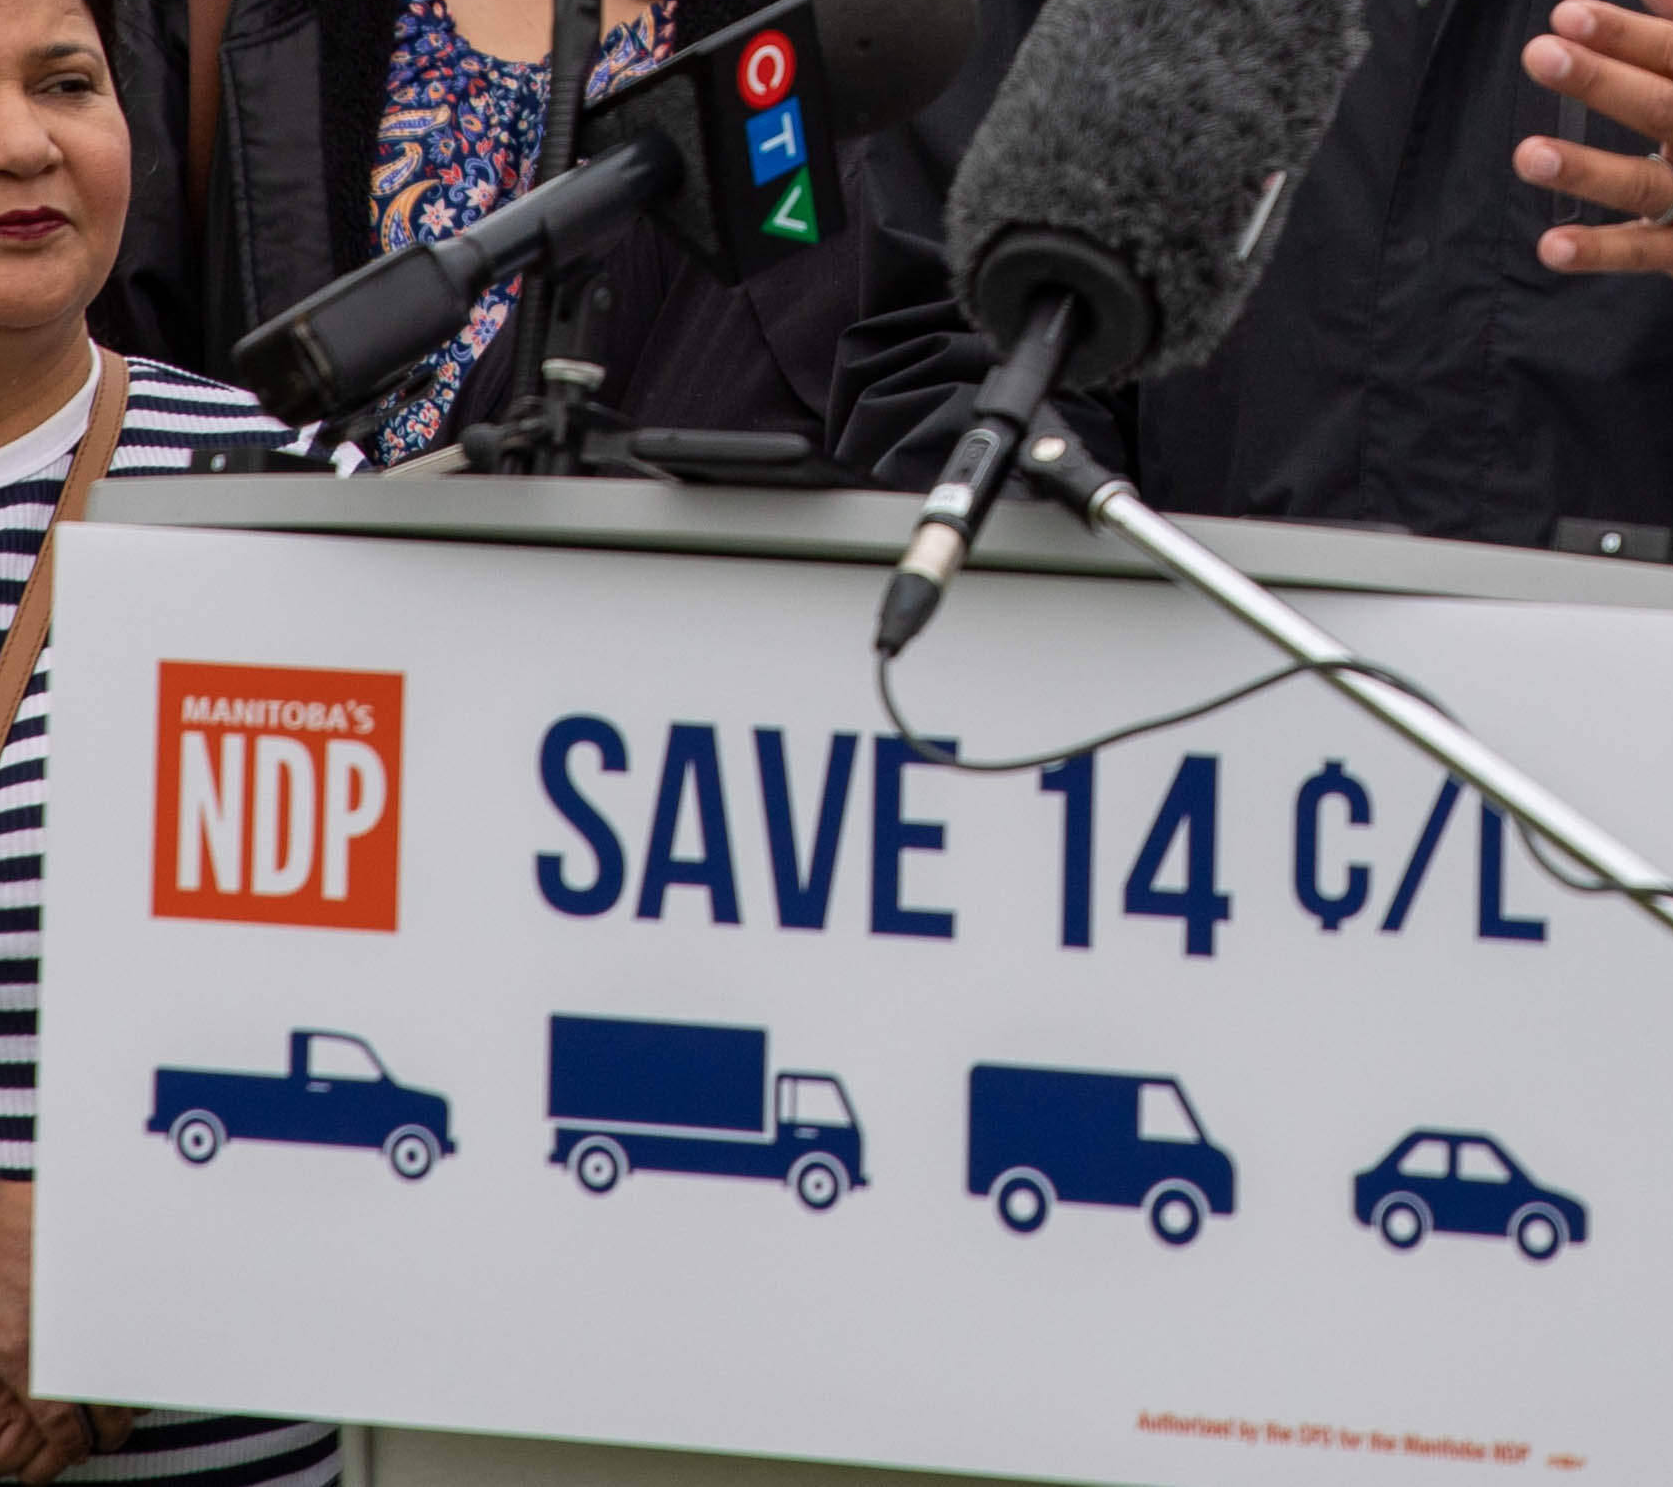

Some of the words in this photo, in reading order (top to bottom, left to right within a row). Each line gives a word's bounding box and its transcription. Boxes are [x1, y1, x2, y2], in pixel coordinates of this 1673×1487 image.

[743, 39, 813, 237] CTV
[181, 695, 375, 735] MANITOBA'S
[176, 729, 388, 902] NDP
[535, 712, 960, 941] SAVE
[1039, 747, 1231, 959] 14
[1136, 1409, 1233, 1438] Authorized
[1238, 1420, 1258, 1445] by
[1264, 1420, 1292, 1444] the
[1339, 1427, 1362, 1451] for
[1369, 1429, 1396, 1453] the
[1403, 1431, 1487, 1463] Manitoba
[1492, 1440, 1532, 1465] NDP
